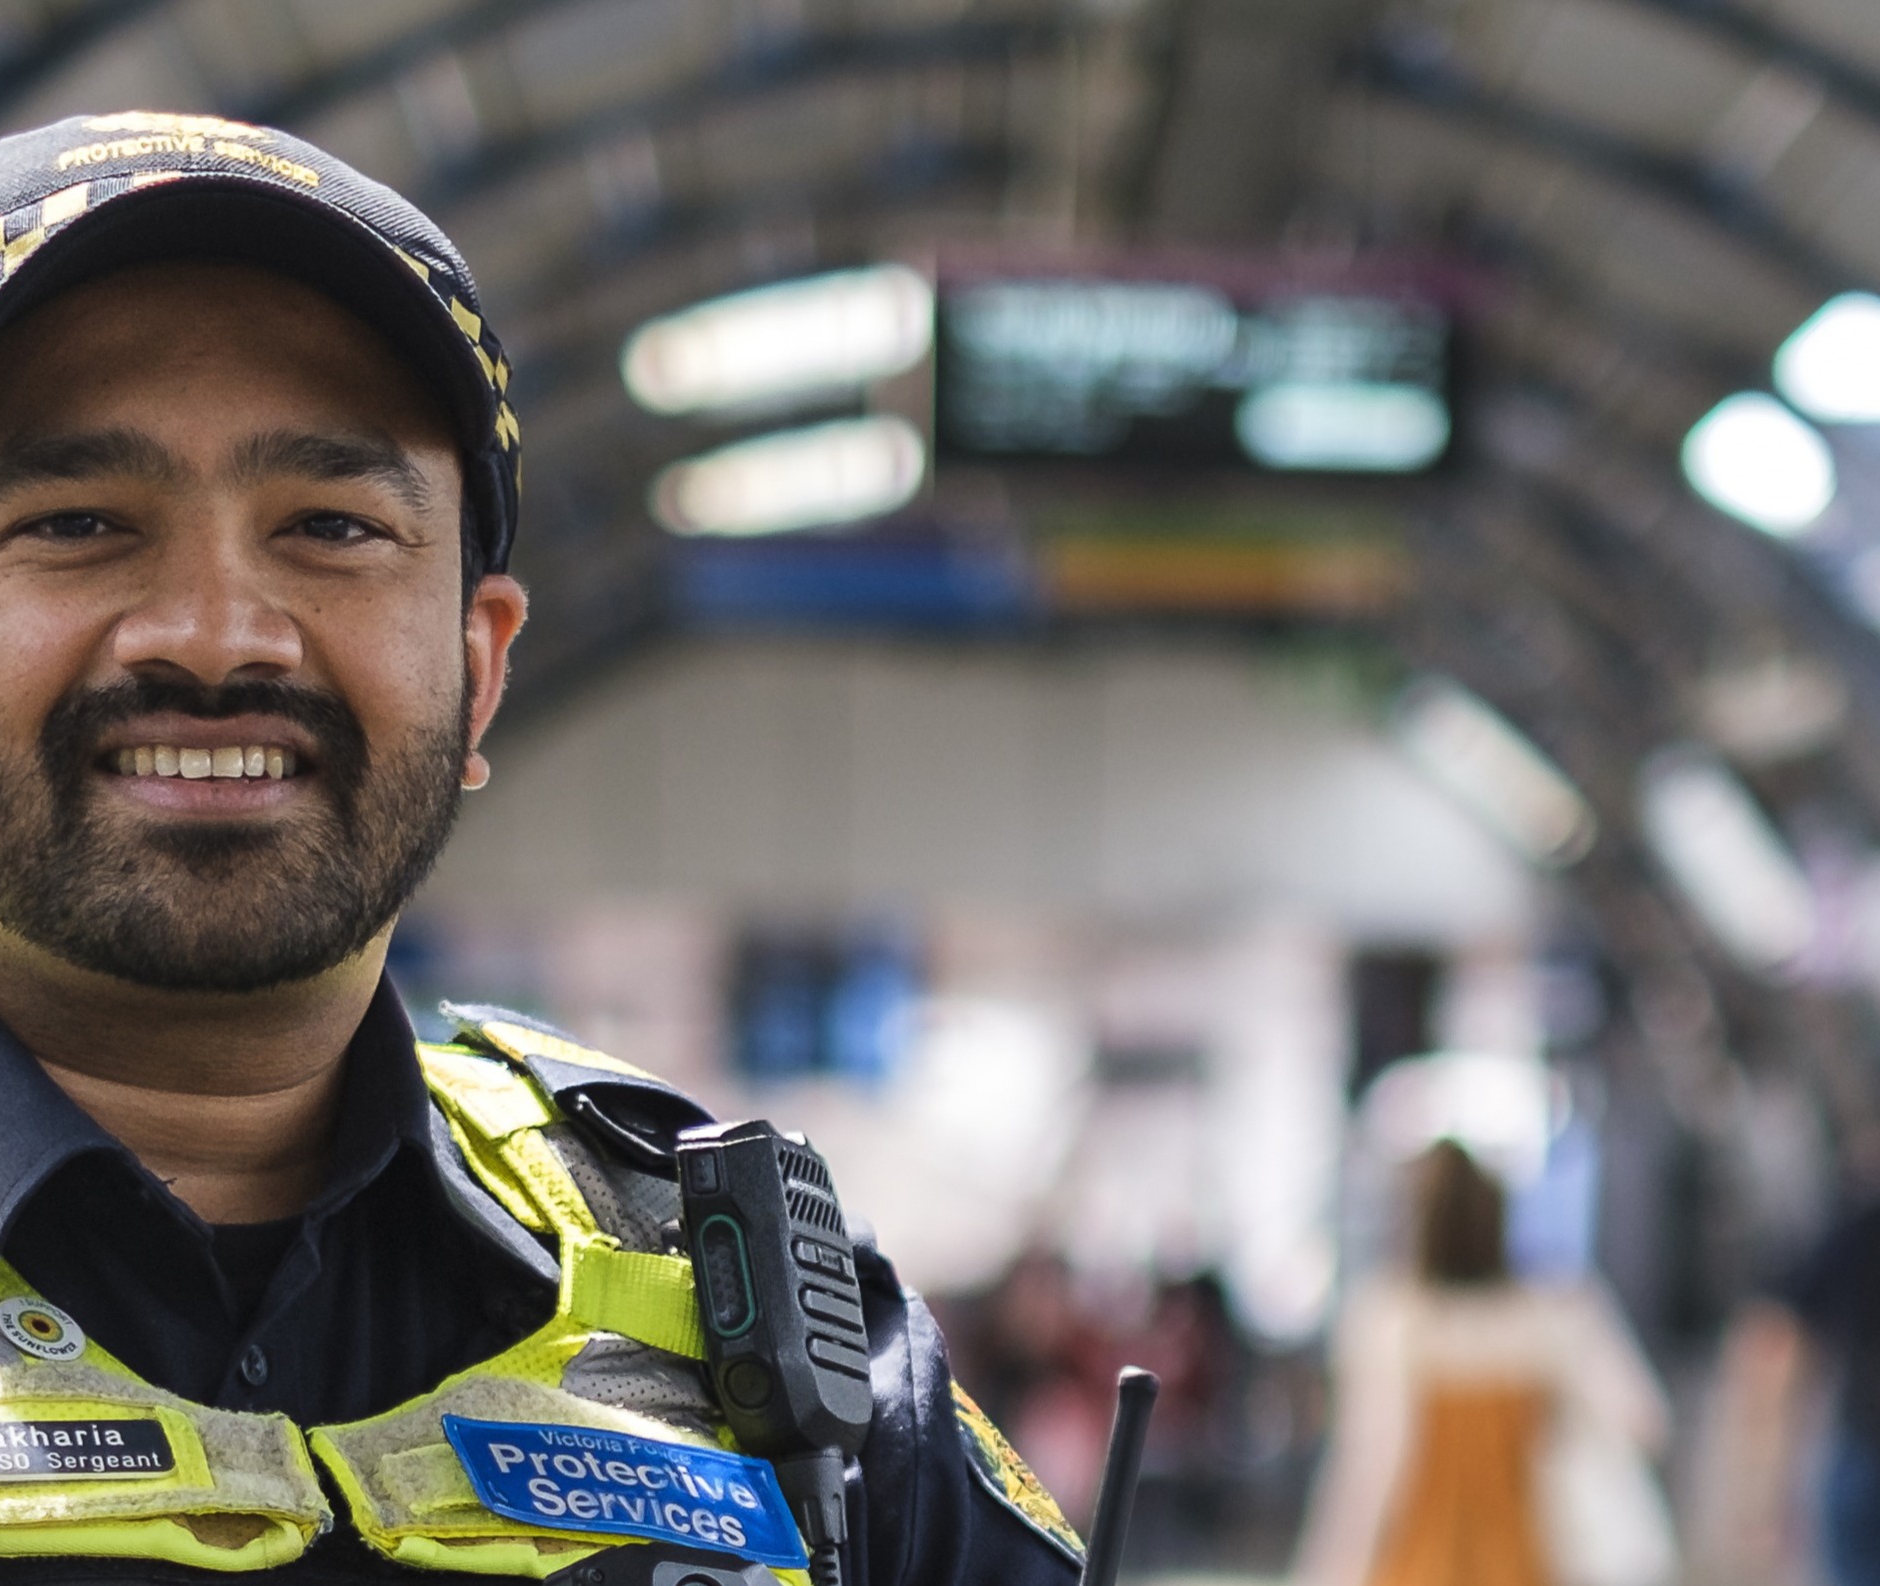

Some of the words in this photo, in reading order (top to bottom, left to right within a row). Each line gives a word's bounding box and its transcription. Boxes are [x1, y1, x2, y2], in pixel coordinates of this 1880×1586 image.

[57, 134, 207, 172] PROTECTIVE
[537, 1429, 623, 1453] Victoria
[47, 1450, 162, 1472] Sergeant
[487, 1442, 761, 1510] Protective
[528, 1478, 747, 1548] Services
